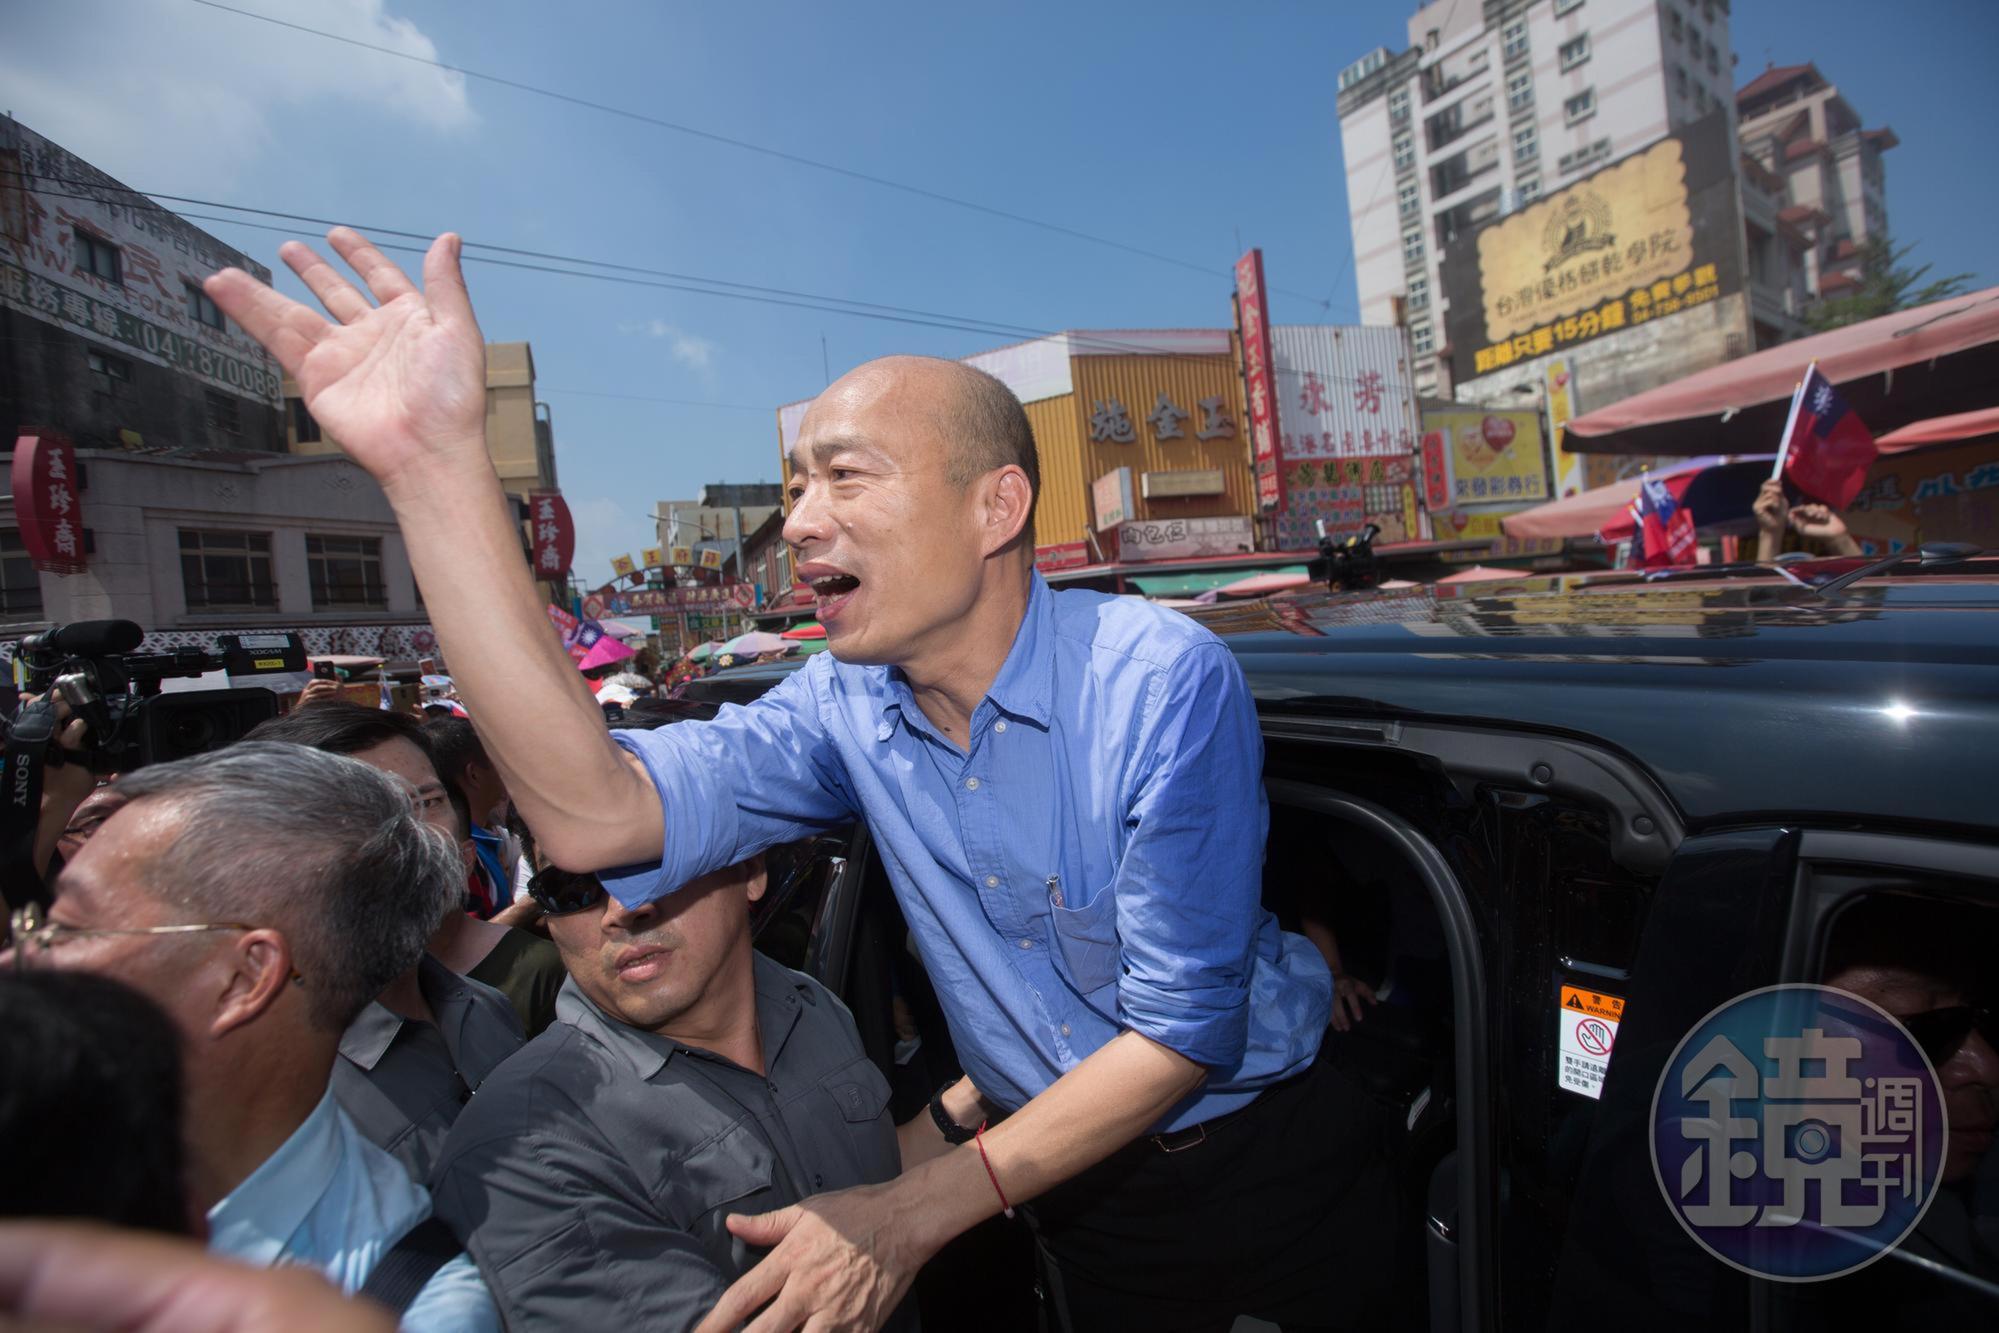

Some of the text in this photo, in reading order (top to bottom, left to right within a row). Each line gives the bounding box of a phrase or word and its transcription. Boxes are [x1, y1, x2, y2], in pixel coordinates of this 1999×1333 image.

[1090, 392, 1235, 443] 施金玉
[14, 754, 30, 806] SONY
